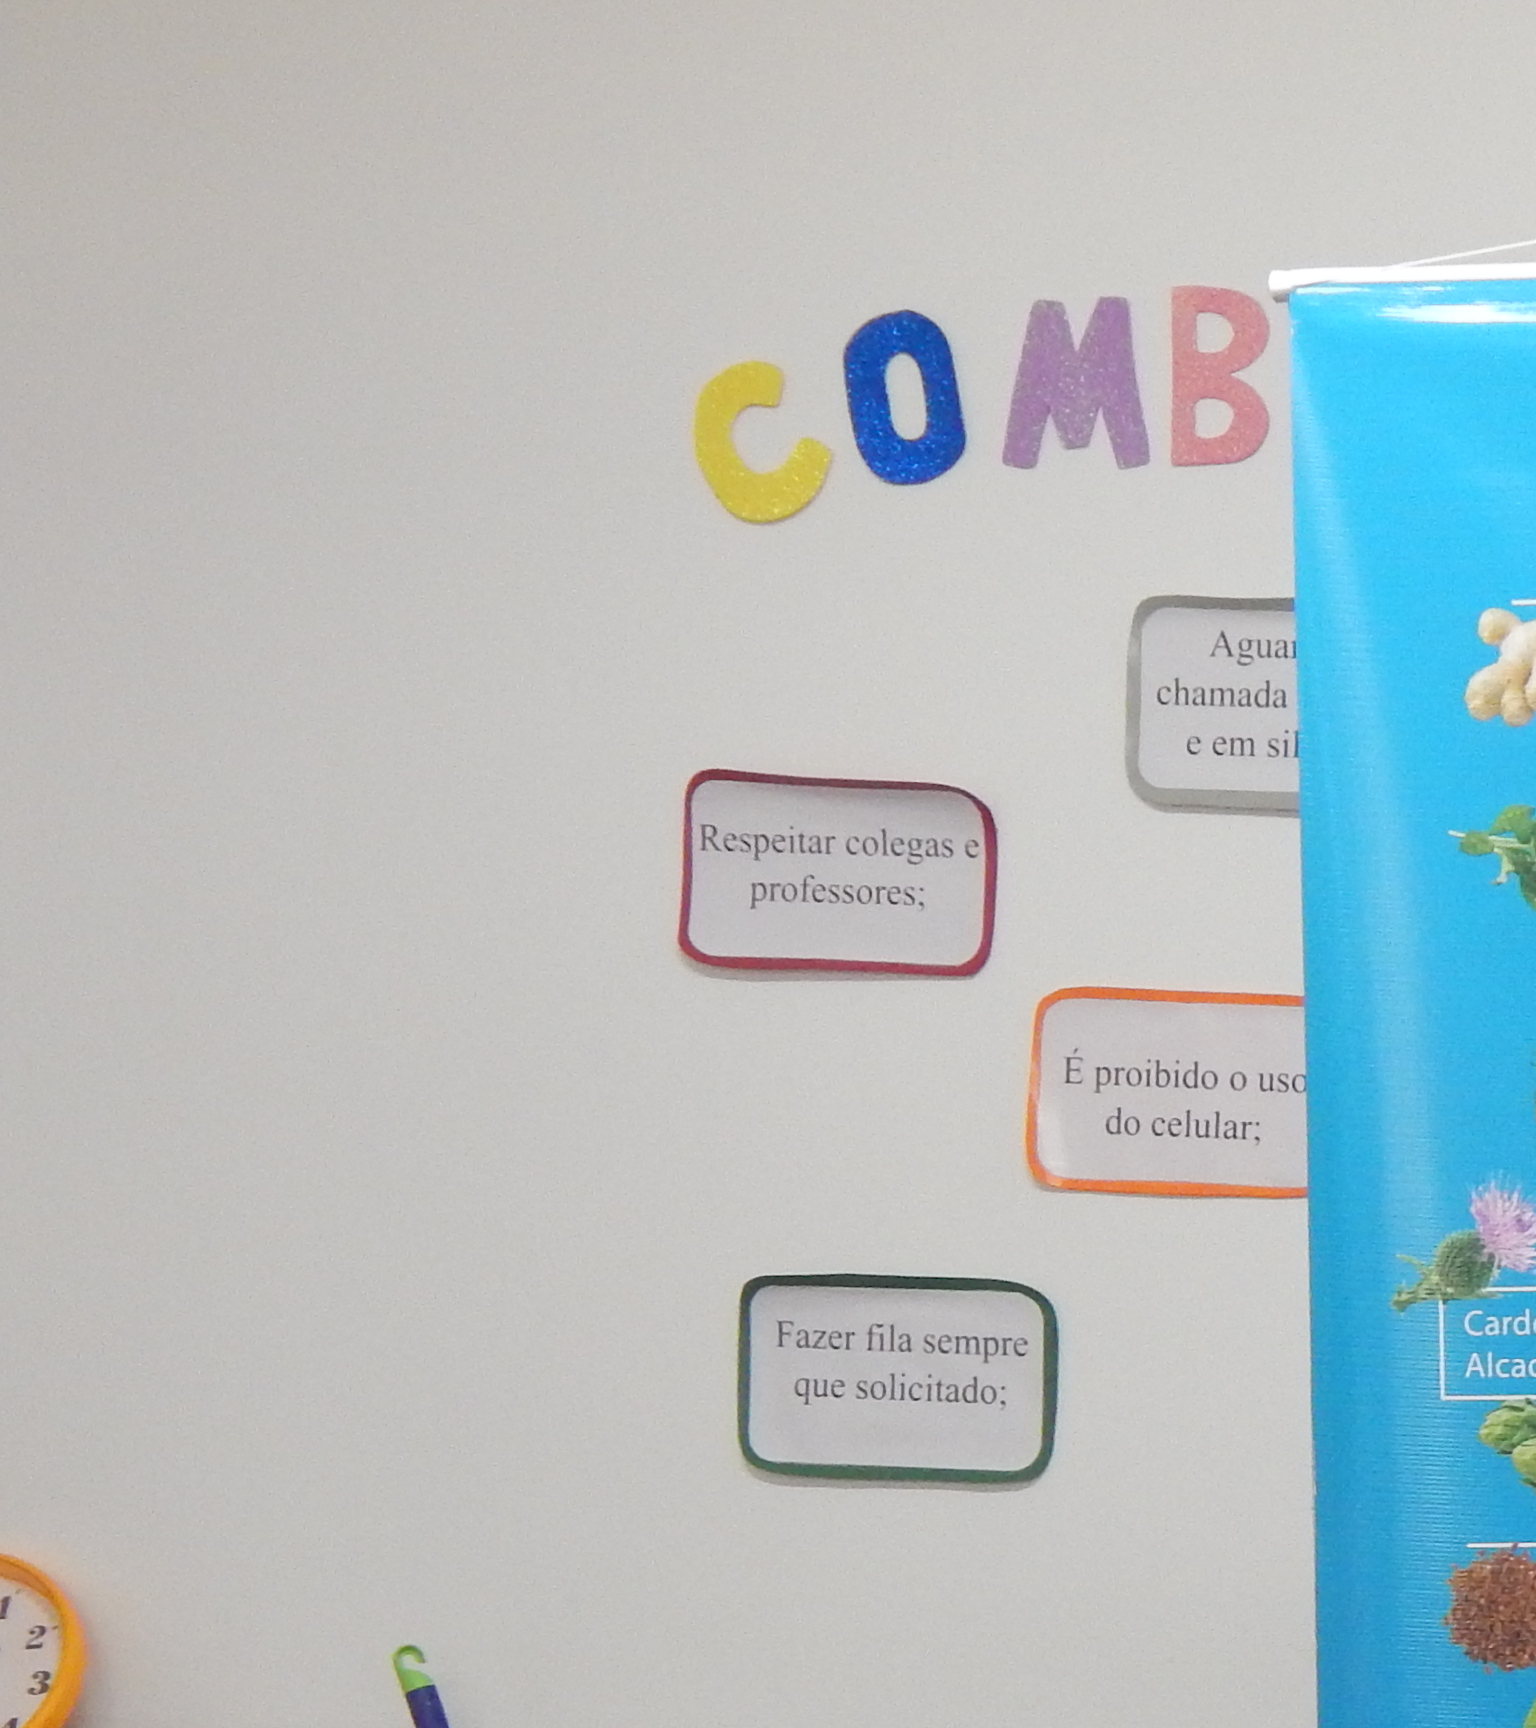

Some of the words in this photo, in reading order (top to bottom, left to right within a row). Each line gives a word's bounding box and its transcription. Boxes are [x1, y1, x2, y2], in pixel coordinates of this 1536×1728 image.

[1156, 677, 1287, 708] chamada
[1186, 734, 1201, 756] e
[1212, 736, 1256, 757] em
[700, 823, 836, 862] Respeitar
[846, 829, 954, 865] colegas
[964, 840, 980, 859] e
[750, 874, 926, 911] professores;
[1064, 1048, 1083, 1085] É
[1094, 1058, 1218, 1093] proibido
[1229, 1072, 1247, 1092] o
[1258, 1072, 1307, 1093] uso
[1105, 1107, 1140, 1136] do
[1151, 1110, 1261, 1146] celular;
[776, 1320, 855, 1351] Fazer
[866, 1323, 912, 1353] fila
[923, 1331, 1029, 1363] sempre
[794, 1376, 846, 1405] que
[855, 1373, 1007, 1410] solicitado;
[25, 1625, 47, 1650] 2
[27, 1670, 51, 1696] 3
